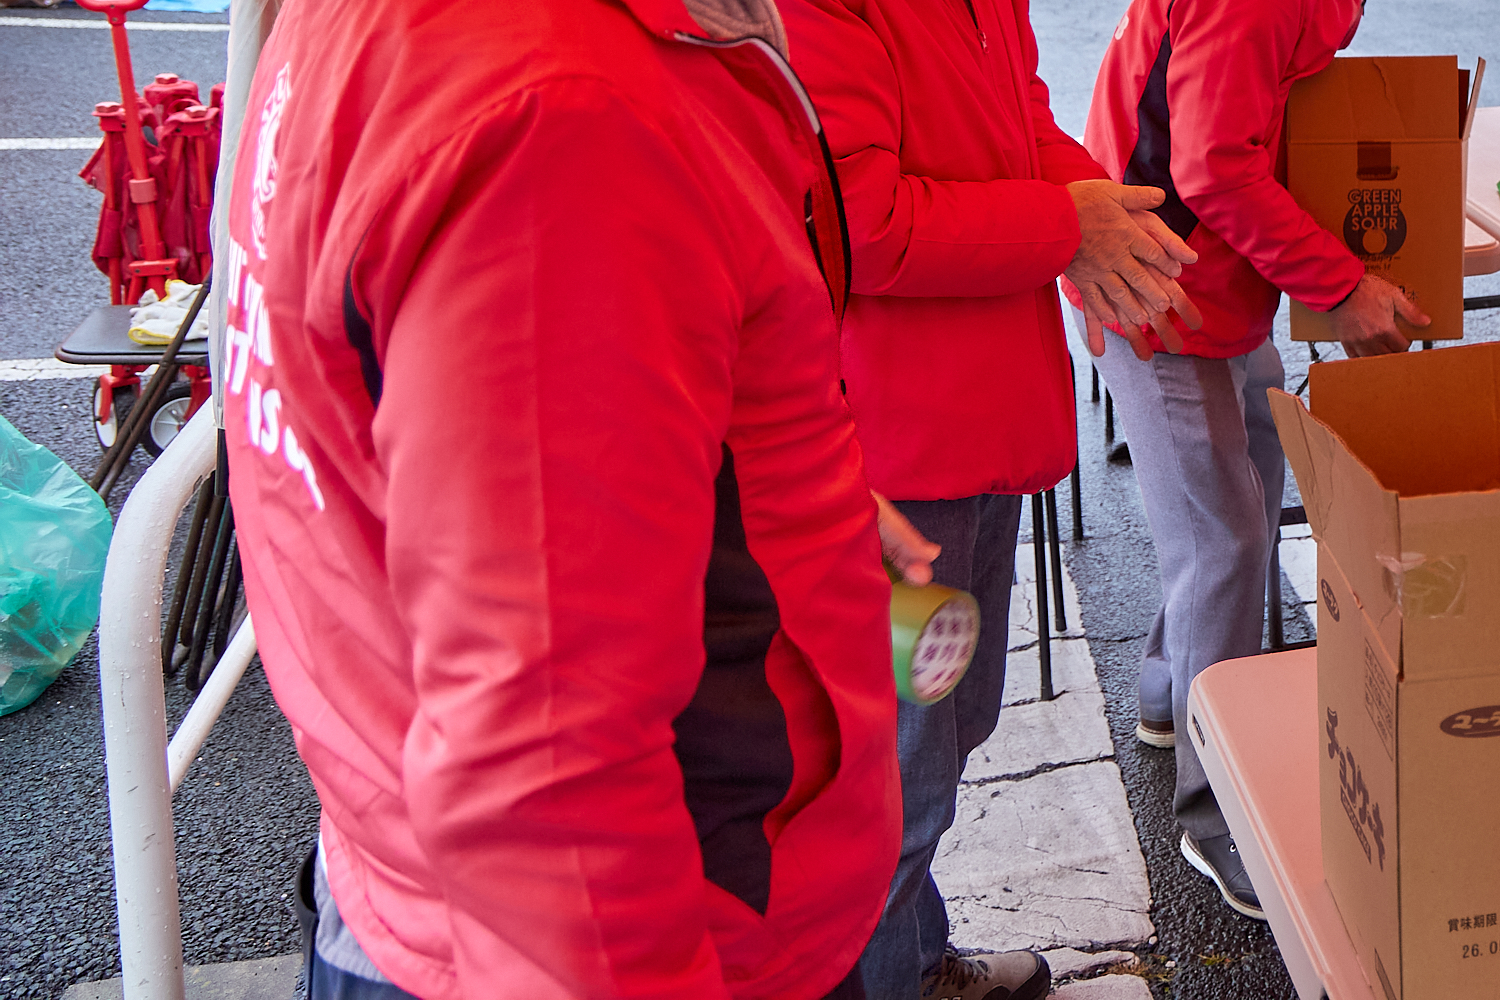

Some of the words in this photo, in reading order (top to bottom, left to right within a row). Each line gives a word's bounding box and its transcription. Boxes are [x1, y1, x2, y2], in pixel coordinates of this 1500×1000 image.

[1347, 188, 1401, 204] GREEN
[1351, 203, 1399, 217] APPLE
[1351, 216, 1398, 231] SOUR
[1448, 913, 1498, 932] 賞味期限
